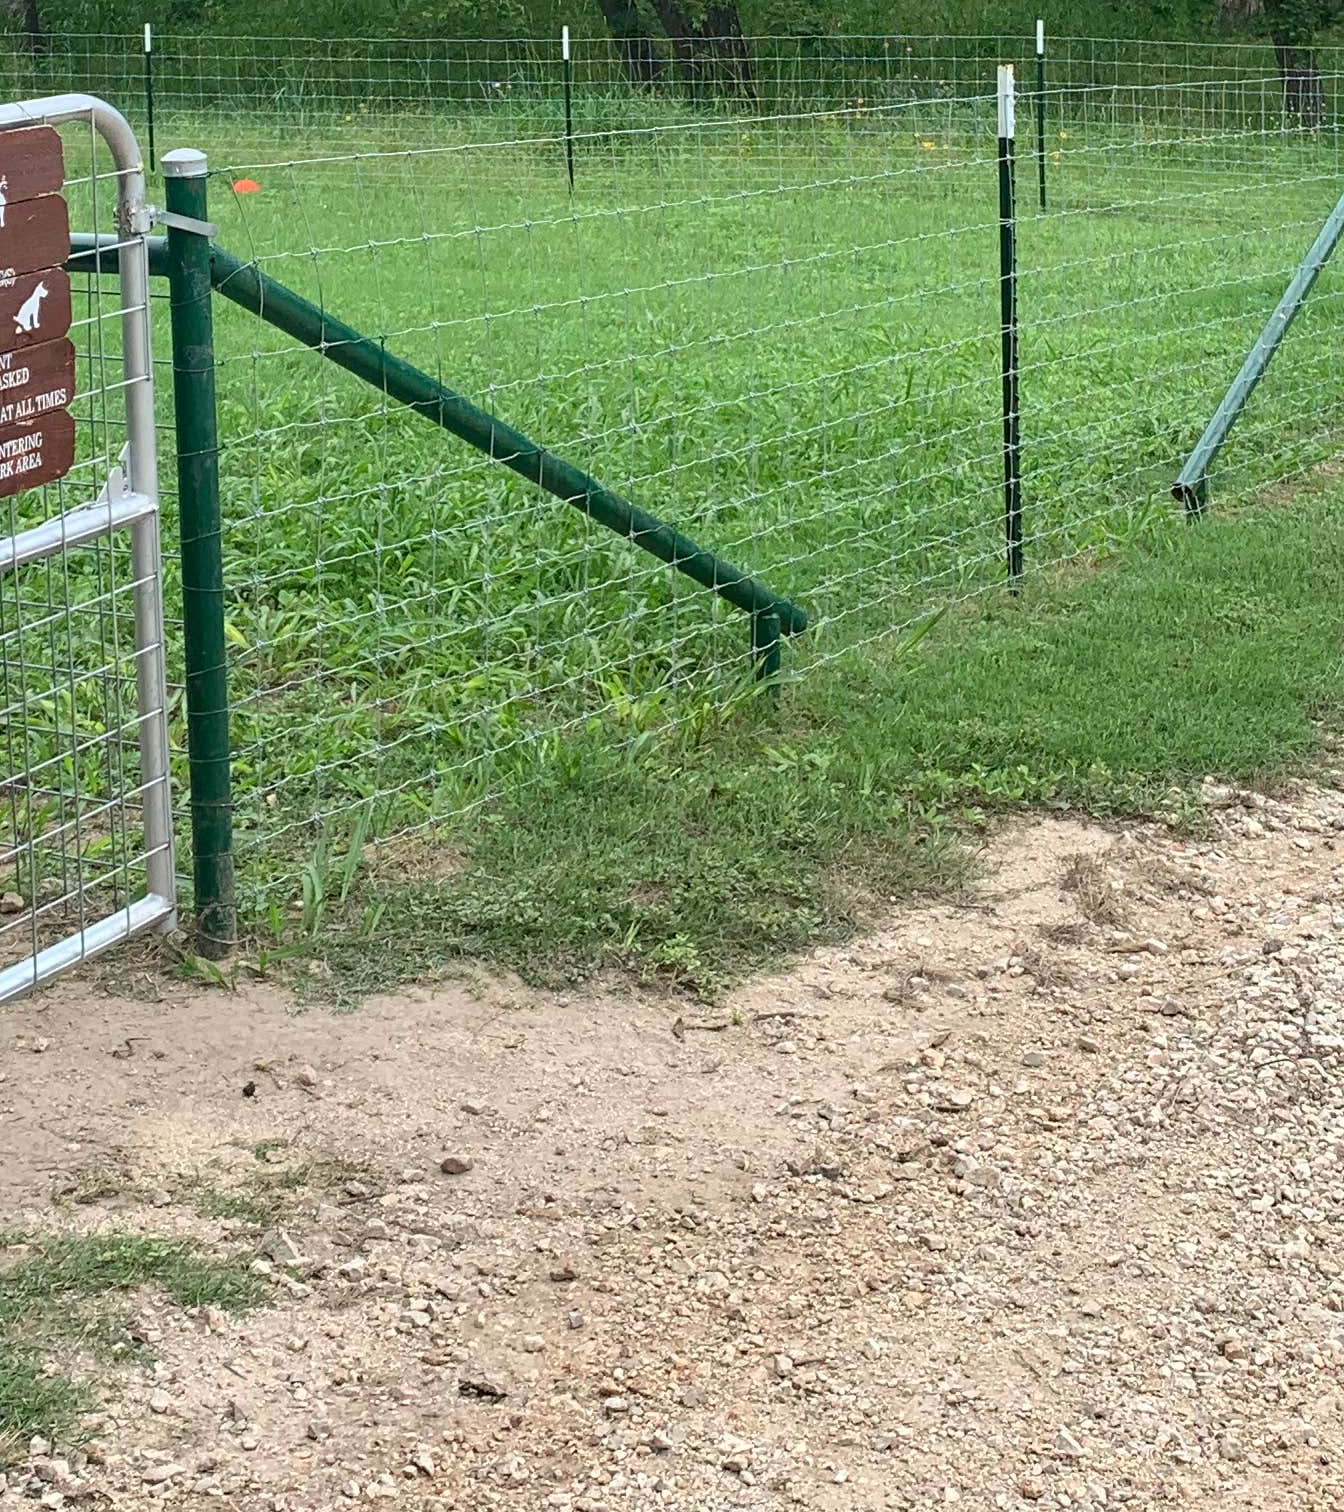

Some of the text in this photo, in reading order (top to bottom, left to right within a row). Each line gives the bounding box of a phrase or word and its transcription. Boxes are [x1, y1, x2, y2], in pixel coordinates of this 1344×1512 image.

[0, 404, 14, 422] AT
[15, 396, 35, 418] ALL
[35, 388, 67, 414] TIMES
[15, 452, 43, 474] AREA
